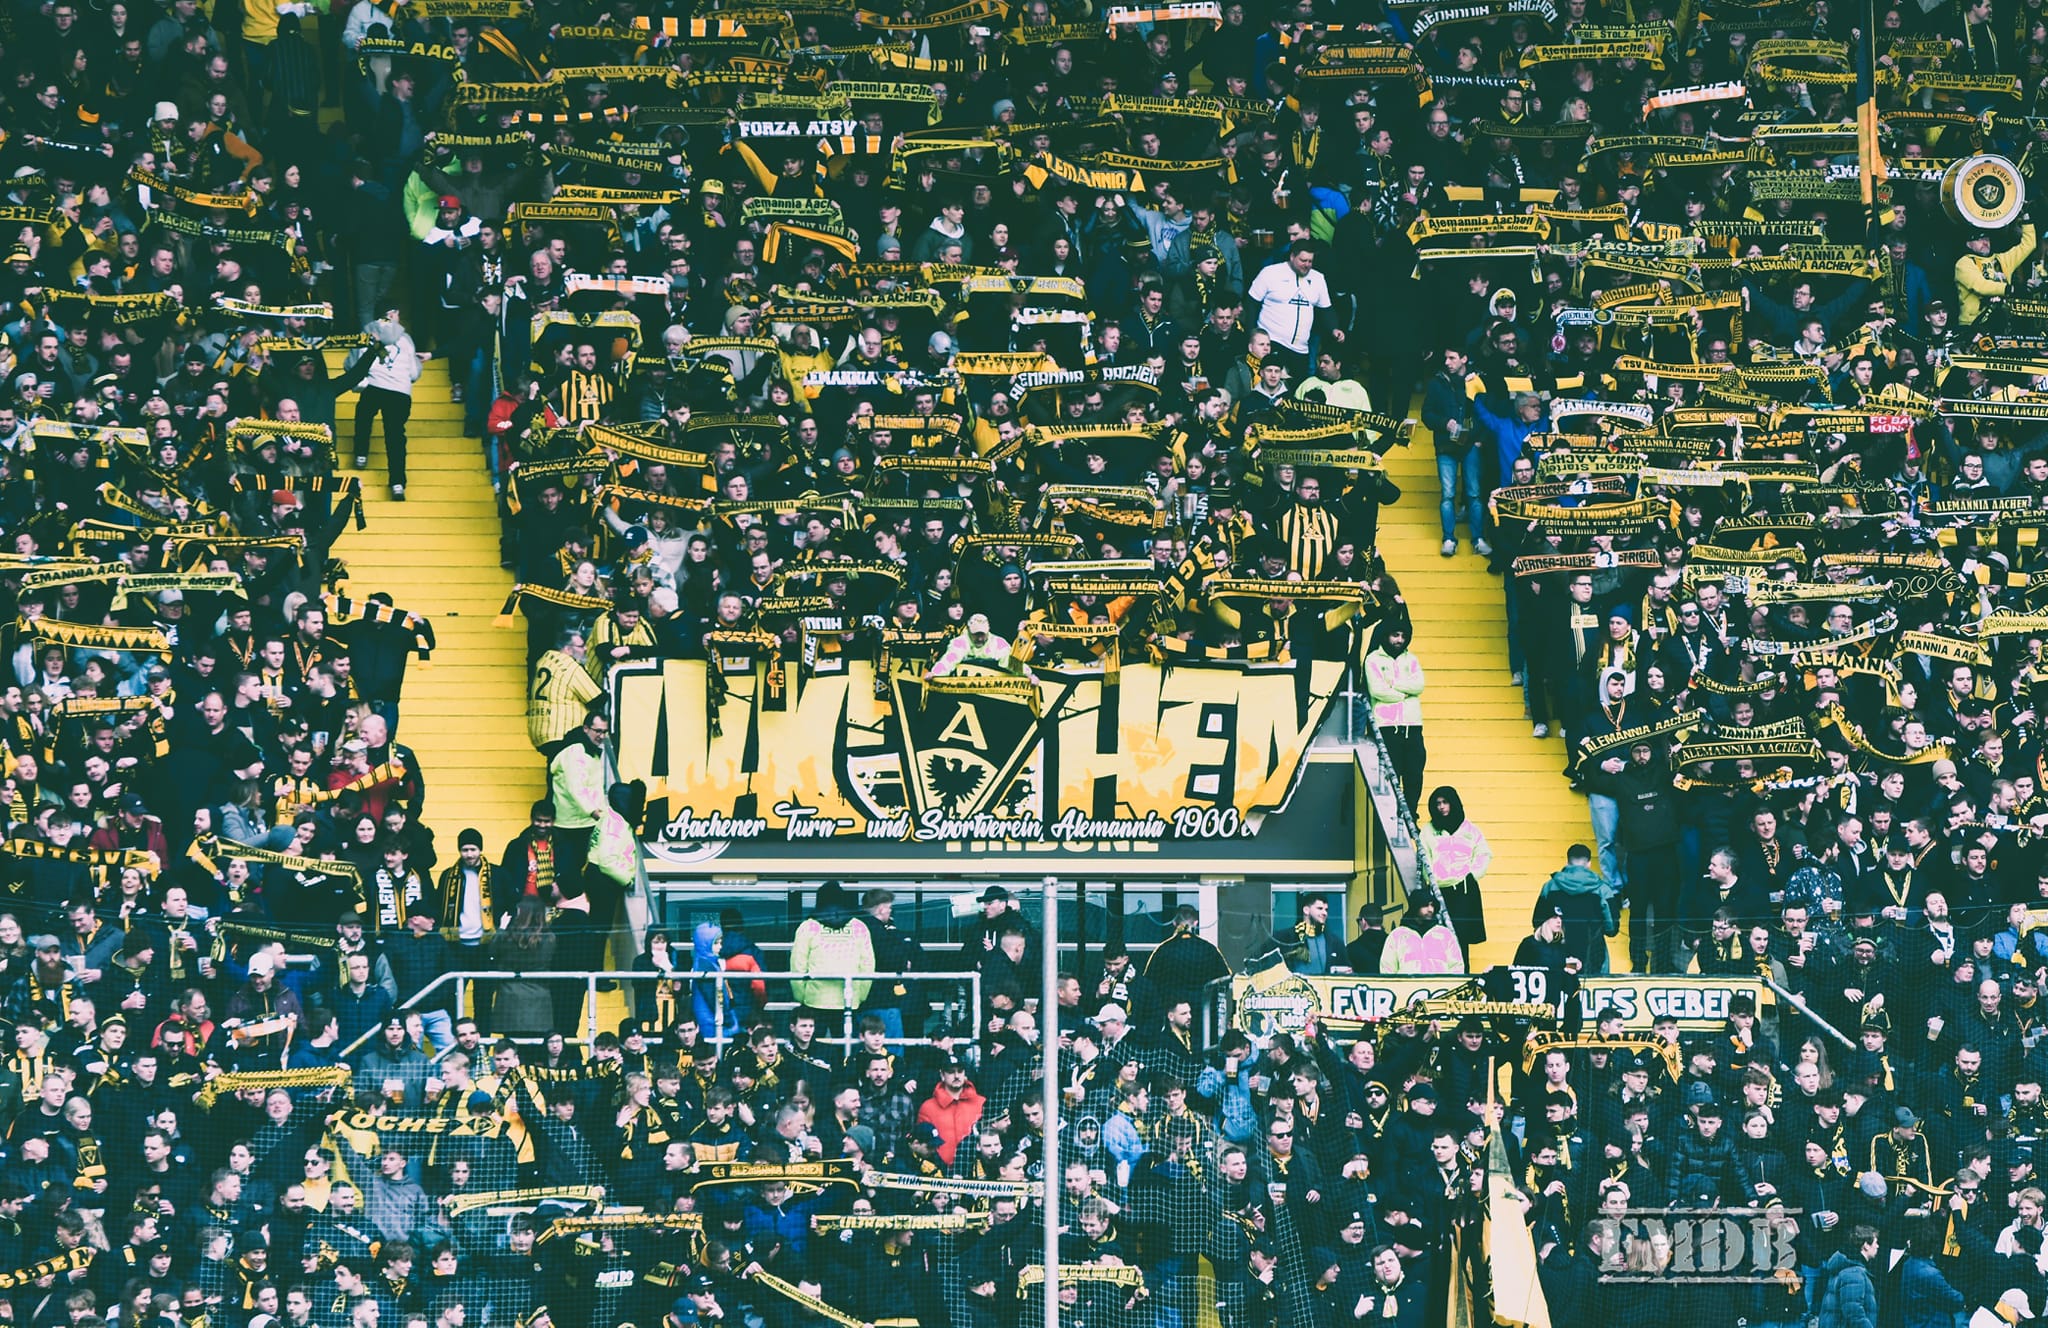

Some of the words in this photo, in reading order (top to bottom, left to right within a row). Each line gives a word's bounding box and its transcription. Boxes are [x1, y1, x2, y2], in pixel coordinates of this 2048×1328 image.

[560, 26, 613, 39] RODA
[620, 30, 648, 42] JC
[1541, 44, 1606, 56] Alemannia
[1967, 72, 2014, 86] Aachen
[1113, 93, 1176, 109] Alemannia
[1177, 97, 1219, 113] Aachen
[1737, 111, 1788, 123] ATSV
[739, 121, 801, 138] FORZA
[807, 120, 858, 137] ATSV
[1758, 124, 1824, 136] Alemannia
[1657, 136, 1703, 149] AACHEN
[1098, 154, 1170, 169] ALEMANNIA
[1668, 149, 1745, 164] ALEMANNIA
[616, 156, 663, 173] AACHEN
[602, 189, 664, 200] ALEMANNEN
[525, 206, 599, 218] ALEMANNIA
[1428, 217, 1489, 230] Alemannia
[1490, 215, 1534, 228] Aachen
[1764, 225, 1814, 237] AACHEN
[1749, 260, 1808, 272] ALEMANNIA
[1810, 260, 1854, 272] AACHEN
[877, 291, 929, 304] AACHEN
[1622, 360, 1642, 370] TSV
[1644, 361, 1695, 373] ALEMANNIA
[1985, 363, 2024, 373] AACHEN
[1953, 403, 2010, 416] ALEMANNIA
[1622, 438, 1673, 450] ALEMANNIA
[1674, 439, 1711, 450] AACHEN
[900, 457, 957, 469] ALEMANNIA
[1325, 451, 1367, 466] Aachen
[518, 461, 571, 479] ALEMANNIA
[572, 458, 610, 471] AACHEN
[1936, 499, 1988, 512] ALEMANNIA
[1992, 498, 2028, 511] AACHEN
[188, 575, 233, 588] AACHEN
[1068, 581, 1126, 593] ALEMANNIA
[1041, 624, 1094, 636] ALEMANNIA
[534, 667, 552, 701] 2
[1584, 722, 1650, 754] ALEMANNIA
[1655, 709, 1702, 732] AACHEN
[1682, 742, 1756, 760] ALEMANNIA
[1757, 741, 1809, 755] AACHEN
[664, 806, 766, 842] Aachener
[773, 802, 854, 842] Turn-
[866, 814, 911, 841] und
[1050, 807, 1166, 842] Alemannia
[1172, 806, 1241, 839] 1900
[22, 840, 122, 866] ATSV
[1510, 971, 1547, 1005] 39
[1331, 984, 1398, 1019] FÜR
